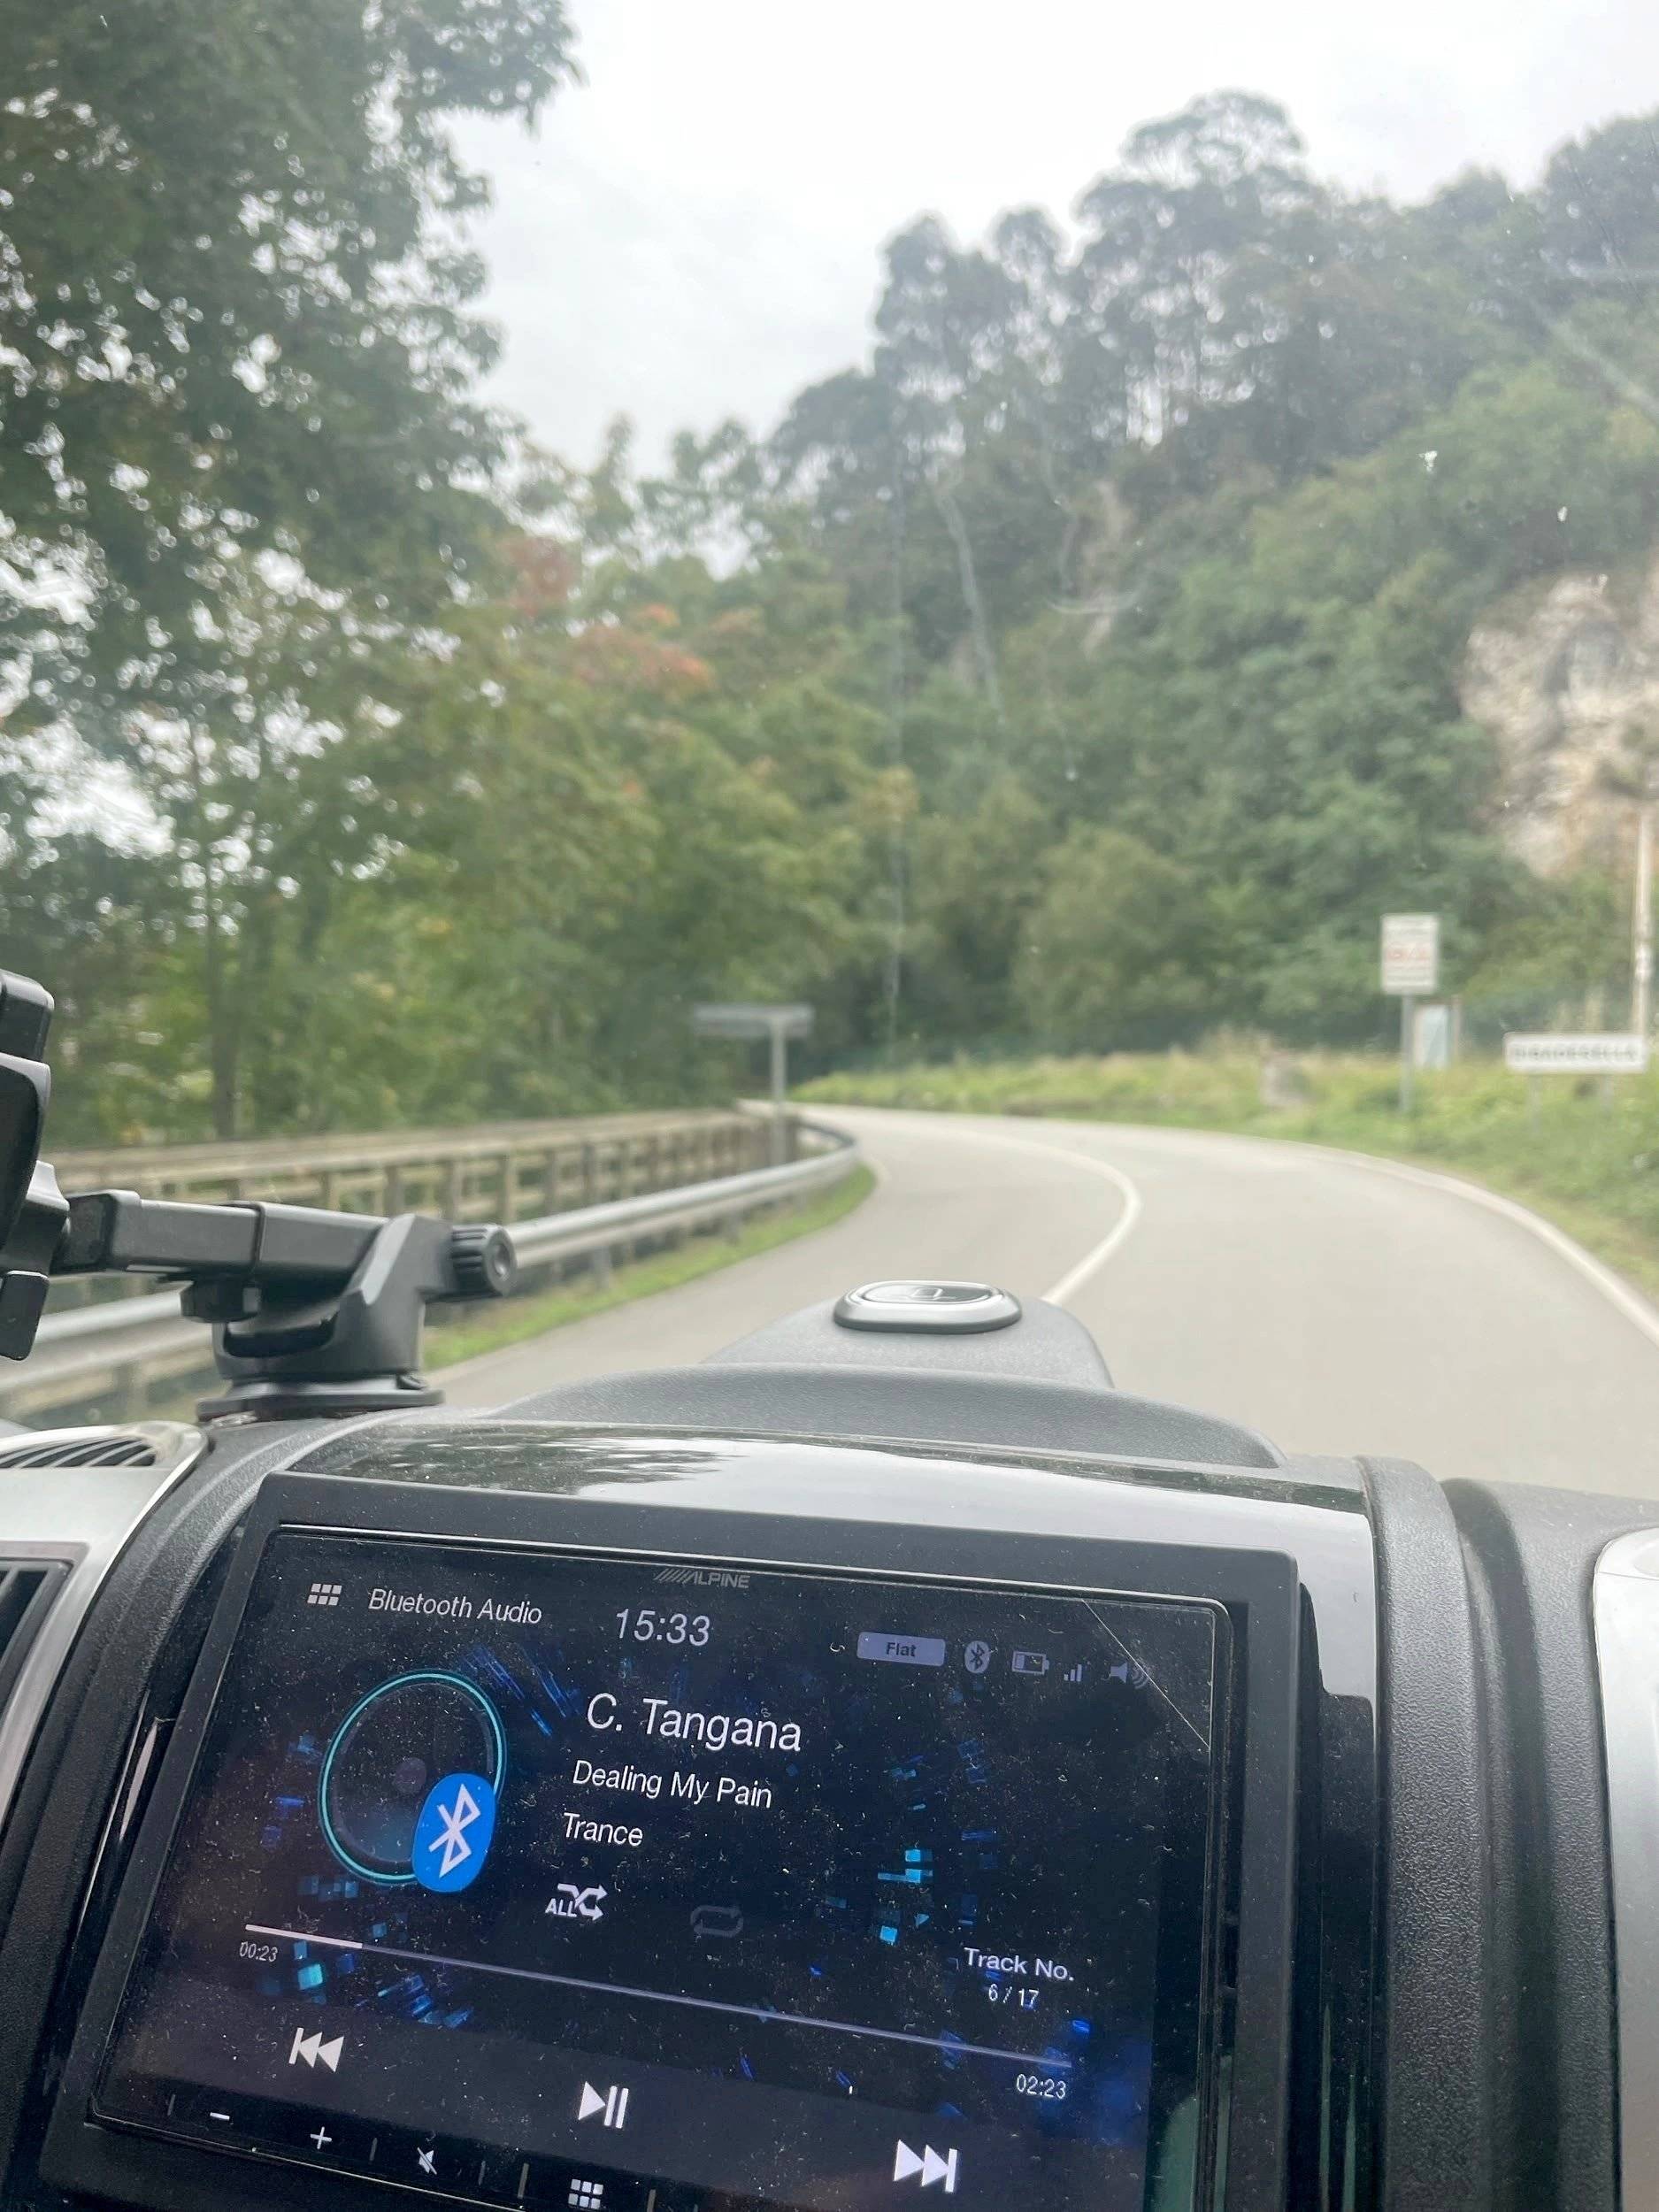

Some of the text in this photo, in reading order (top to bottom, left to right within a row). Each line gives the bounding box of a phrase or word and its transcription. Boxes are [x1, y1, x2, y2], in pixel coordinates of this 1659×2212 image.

[682, 1571, 751, 1589] ALPINE
[368, 1588, 542, 1624] Bluetooth Audio
[616, 1609, 710, 1646] 15:33
[886, 1641, 917, 1657] Flat
[587, 1693, 801, 1752] C. Tangana
[572, 1760, 772, 1809] Dealing My Pain
[564, 1812, 643, 1847] Trance
[544, 1898, 578, 1917] ALL
[239, 1940, 279, 1962] 00:23
[964, 1947, 1075, 1982] Track No.
[1016, 2073, 1067, 2100] 02:23
